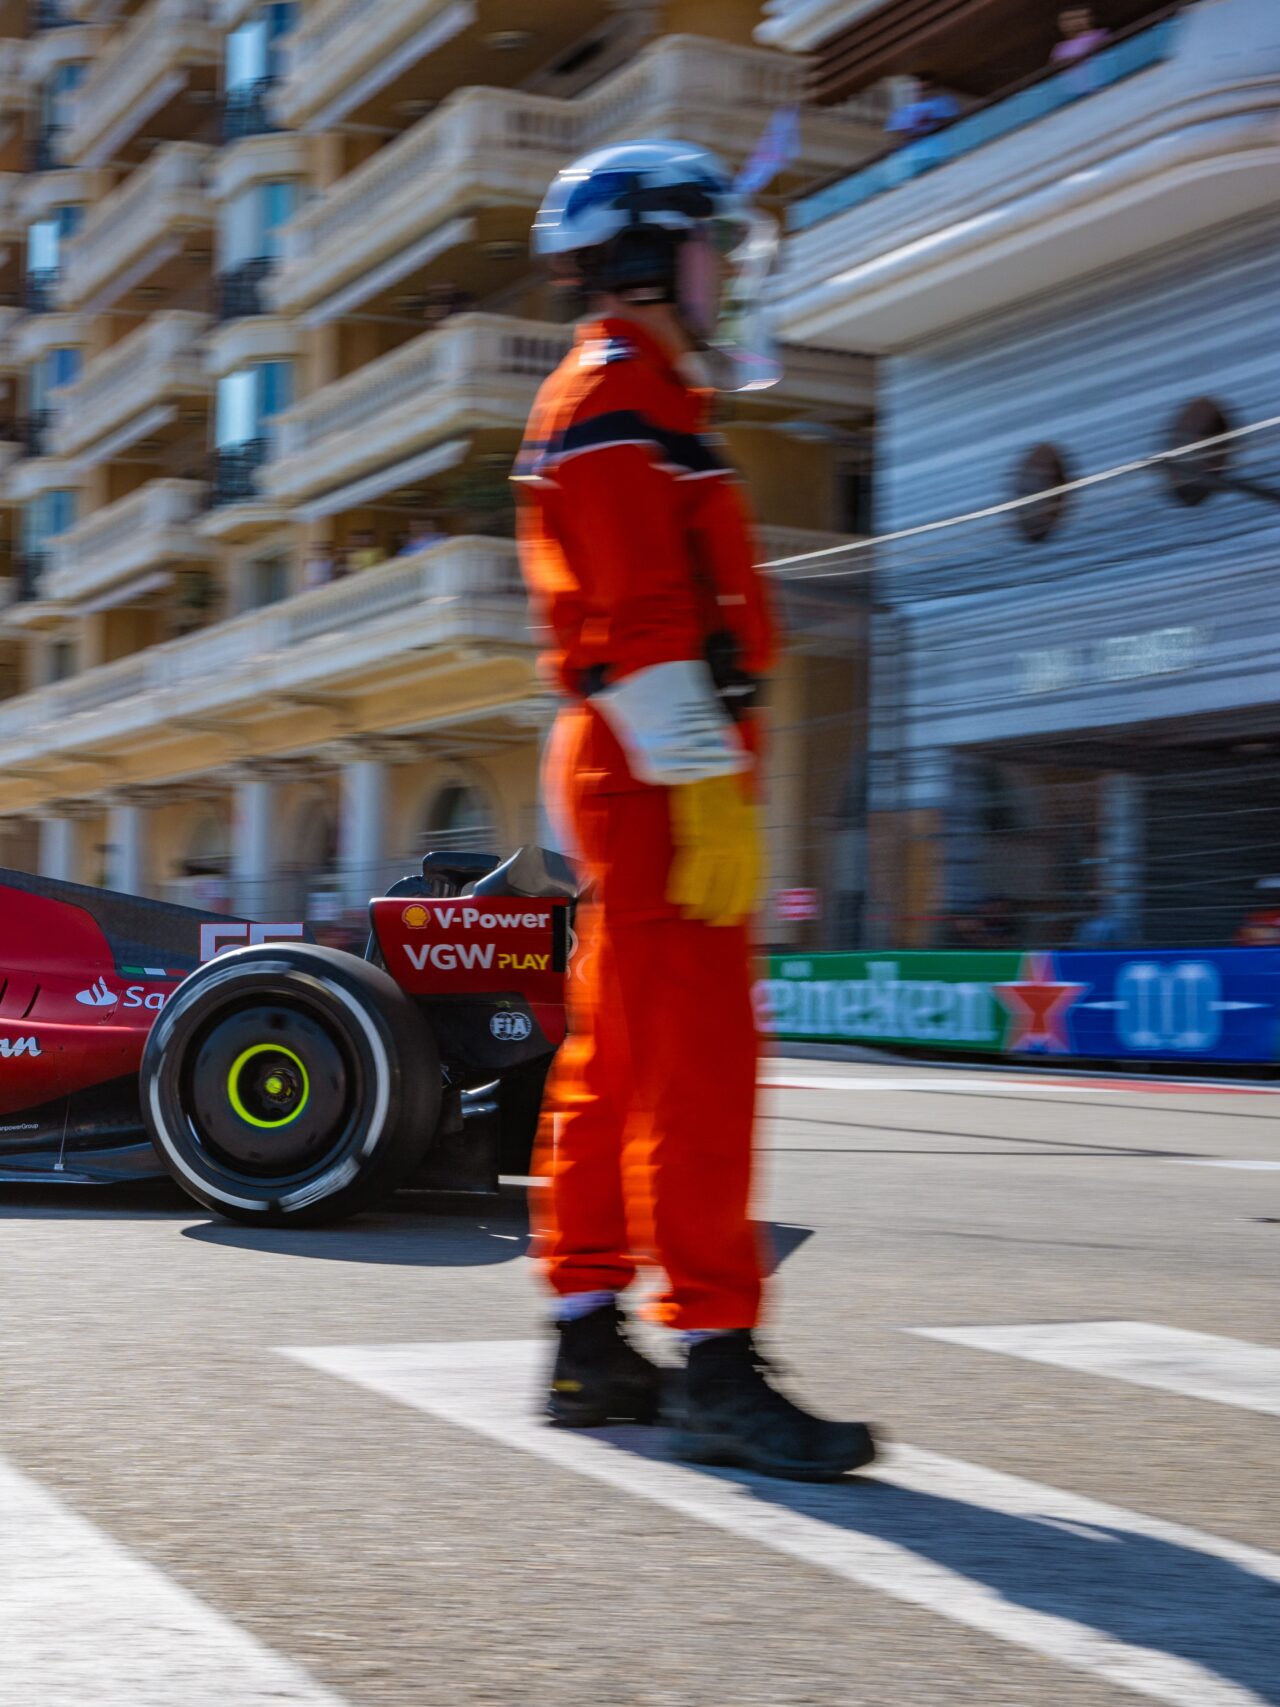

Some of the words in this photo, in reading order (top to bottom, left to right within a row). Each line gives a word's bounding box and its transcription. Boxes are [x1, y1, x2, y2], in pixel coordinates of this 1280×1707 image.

[433, 907, 551, 929] V-Power
[402, 943, 496, 970] VGW
[497, 953, 551, 970] PLAY
[122, 985, 166, 1010] Sa
[749, 960, 999, 1041] eineken
[493, 1017, 529, 1034] FIA
